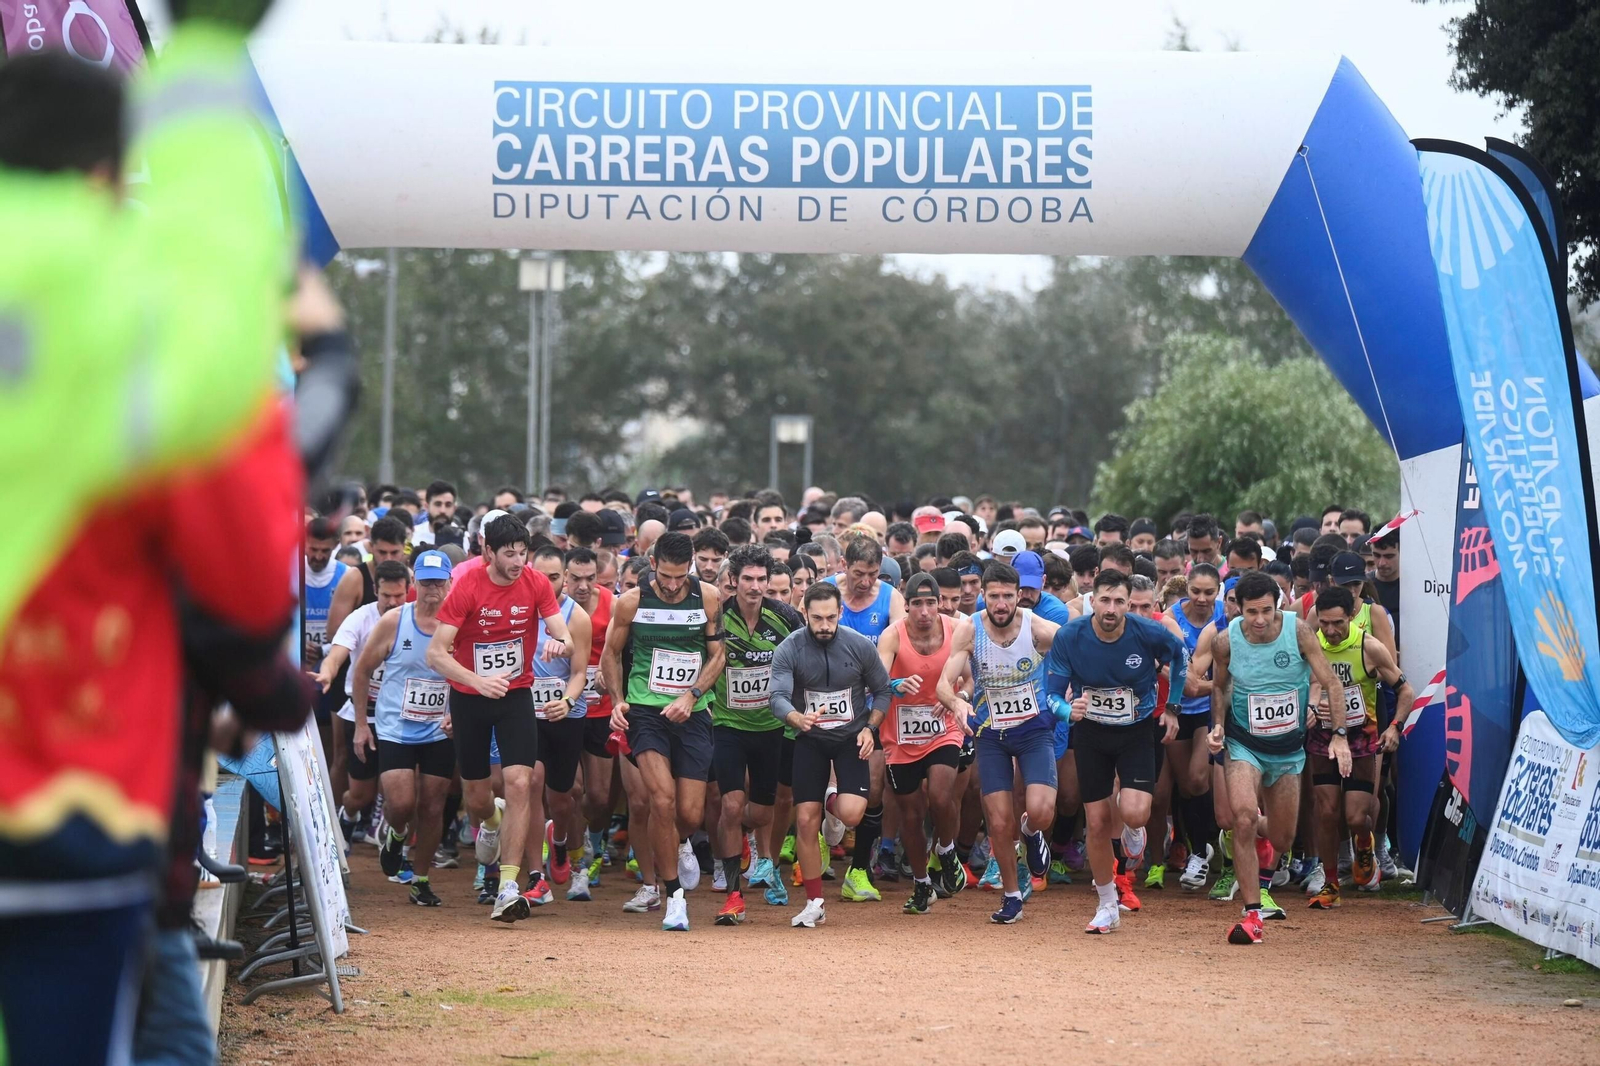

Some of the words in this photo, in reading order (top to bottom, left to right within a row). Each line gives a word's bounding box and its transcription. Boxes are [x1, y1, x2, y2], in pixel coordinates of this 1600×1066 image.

[492, 87, 713, 129] CIRCUITO
[734, 90, 1017, 131] PROVINCIAL
[1036, 91, 1092, 130] DE
[492, 133, 769, 183] CARRERAS
[792, 135, 1093, 184] POPULARES
[493, 187, 763, 222] DIPUTACIÓN
[798, 196, 848, 222] DE
[882, 189, 1095, 224] CÓRDOBA
[482, 651, 517, 670] 555
[655, 665, 696, 682] 1197
[731, 678, 770, 694] 1047
[408, 690, 446, 706] 1108
[1092, 695, 1126, 711] 543
[994, 698, 1033, 716] 1218
[1255, 703, 1295, 720] 1040
[903, 720, 941, 735] 1200
